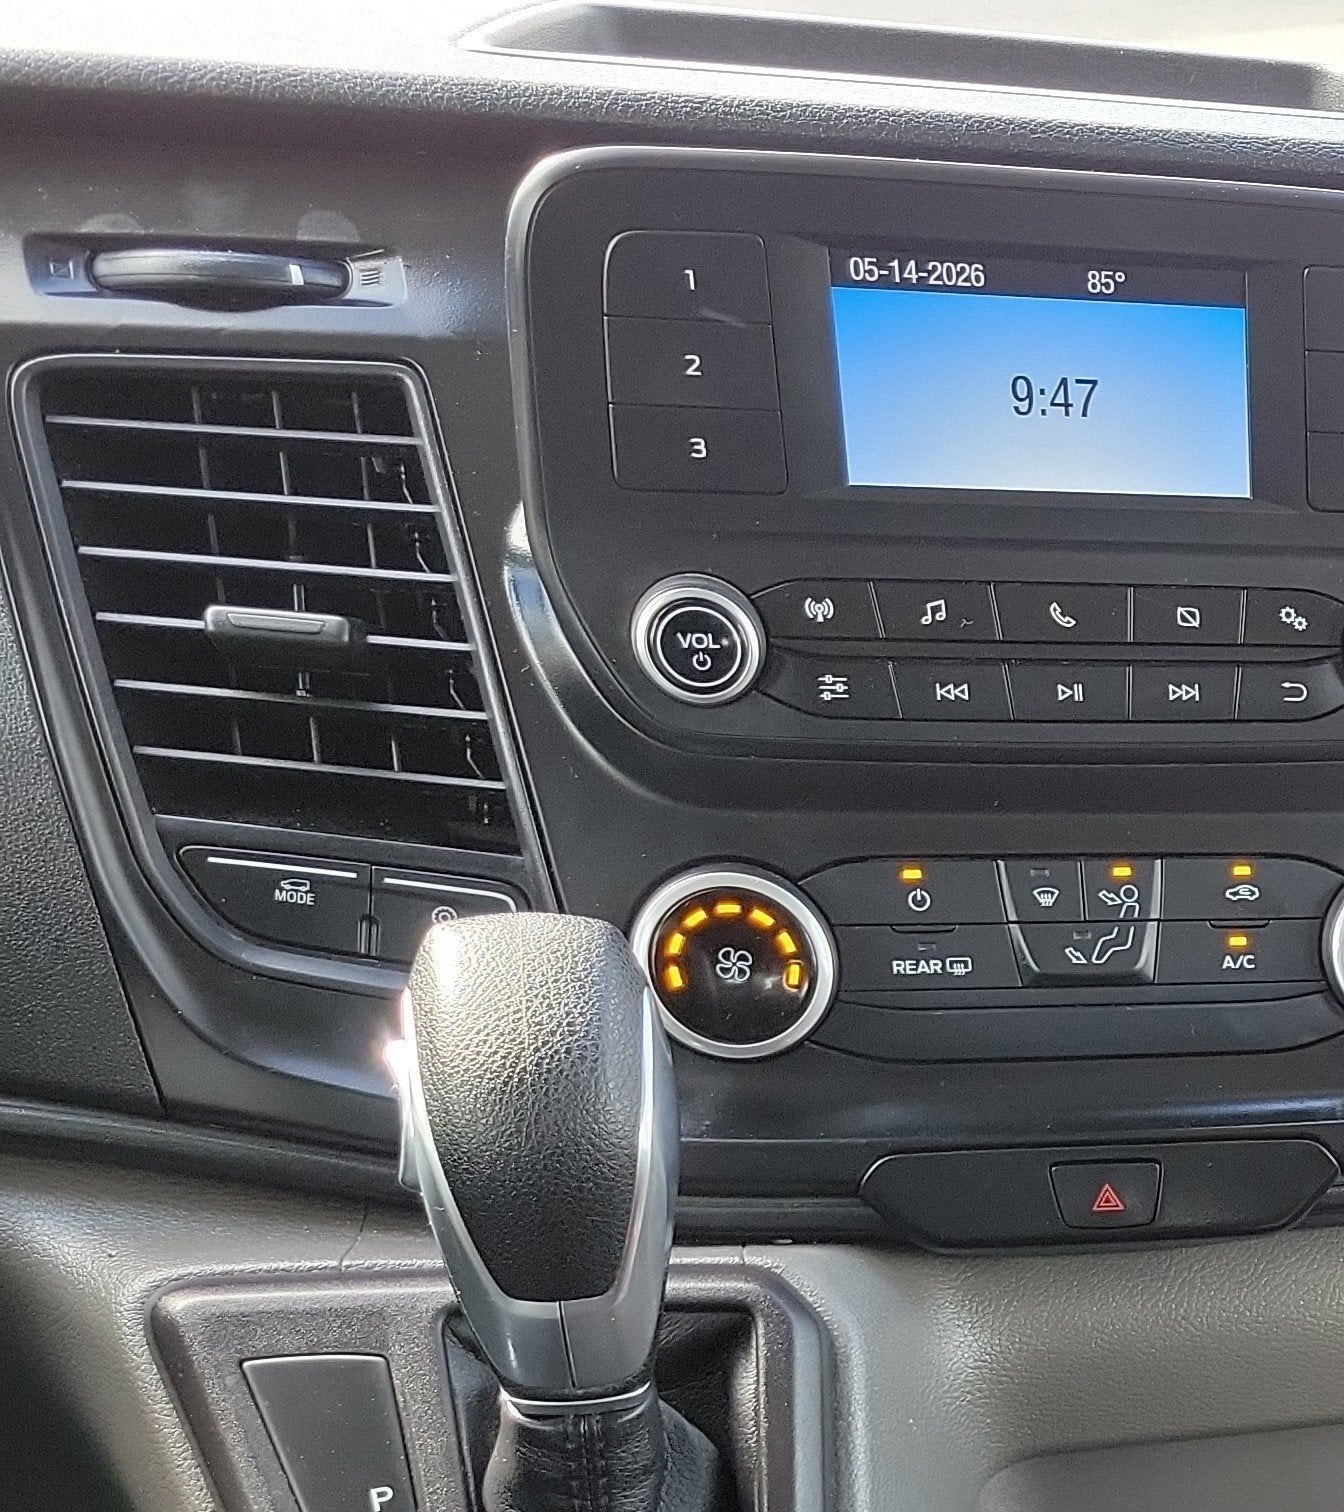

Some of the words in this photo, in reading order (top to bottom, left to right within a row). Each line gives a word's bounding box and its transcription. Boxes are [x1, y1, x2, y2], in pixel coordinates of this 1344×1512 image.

[684, 269, 695, 291] 1
[848, 256, 986, 288] 05-14-2026
[684, 354, 702, 376] 2
[1010, 374, 1100, 419] 9:47
[689, 437, 707, 458] 3
[676, 631, 722, 651] VOL
[274, 888, 315, 906] MODE
[892, 959, 943, 976] REAR
[1221, 952, 1256, 971] A/C
[369, 1486, 394, 1512] P
